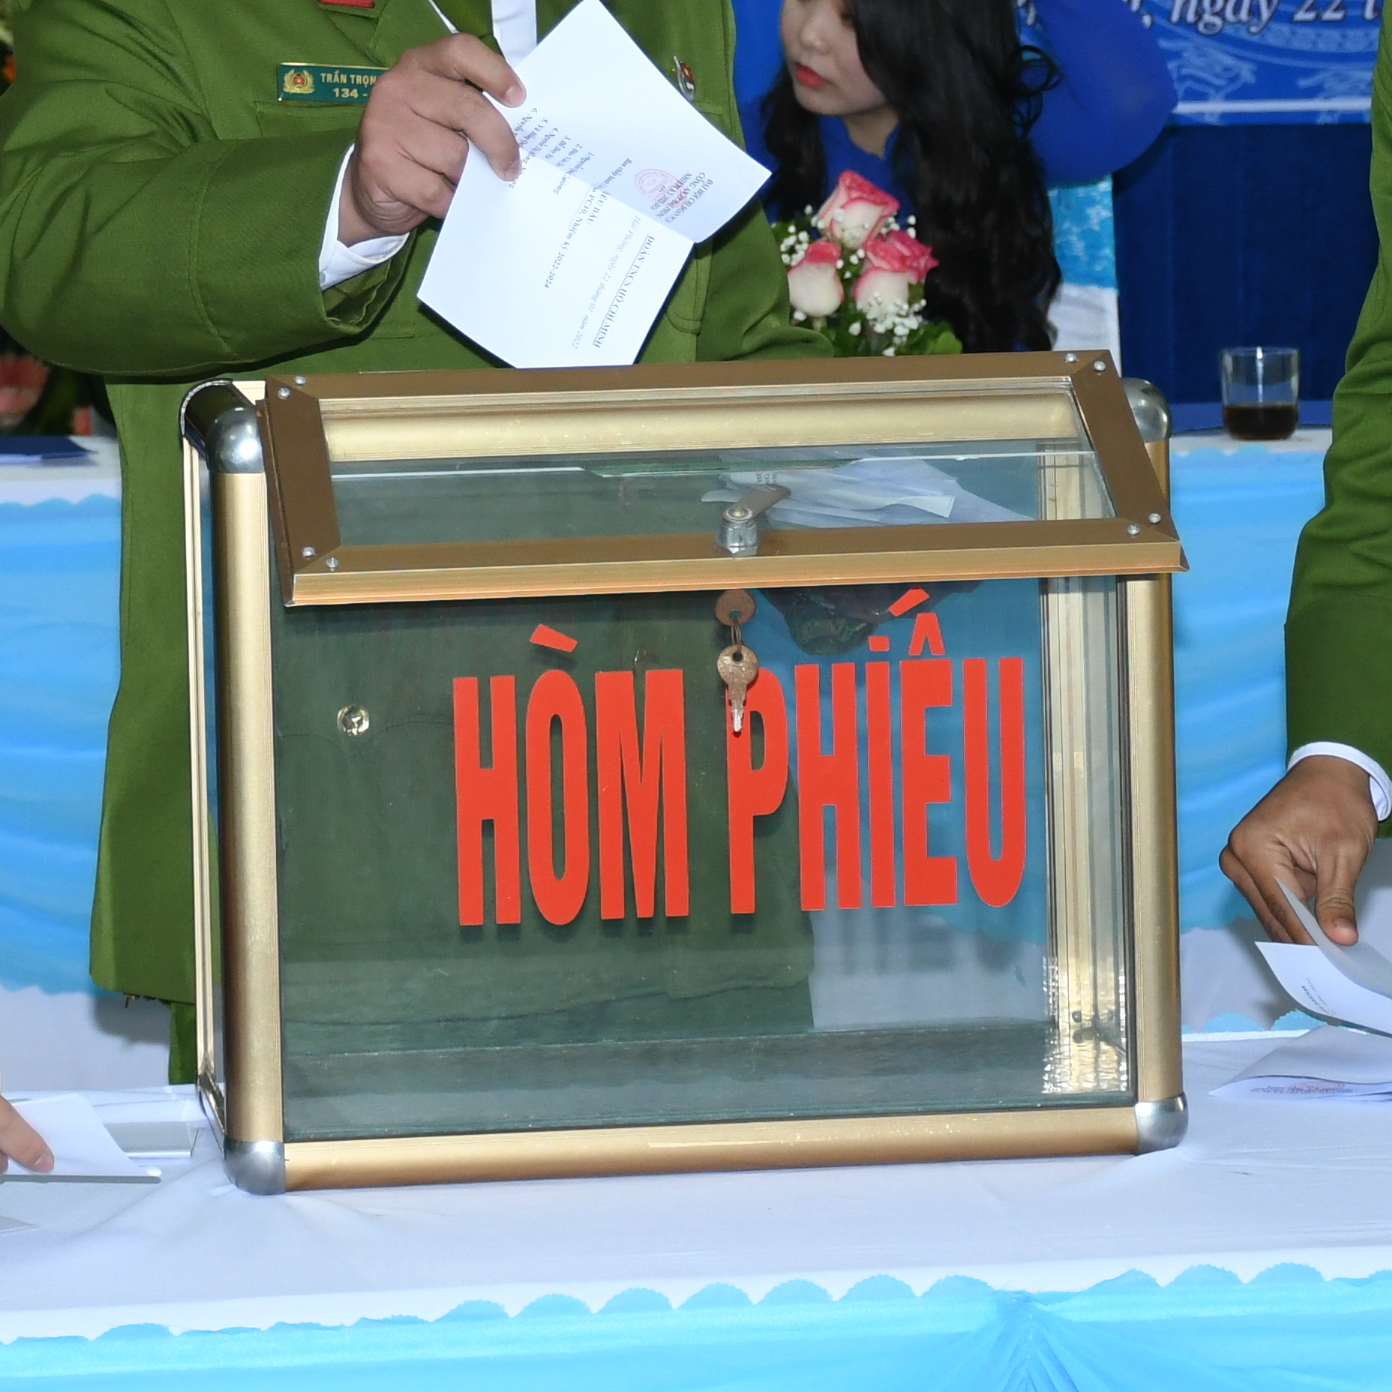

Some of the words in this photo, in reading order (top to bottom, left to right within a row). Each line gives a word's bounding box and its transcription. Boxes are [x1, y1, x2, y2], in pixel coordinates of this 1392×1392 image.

[350, 74, 377, 88] TRỌN
[333, 88, 359, 98] 134
[453, 623, 690, 927] HÒM
